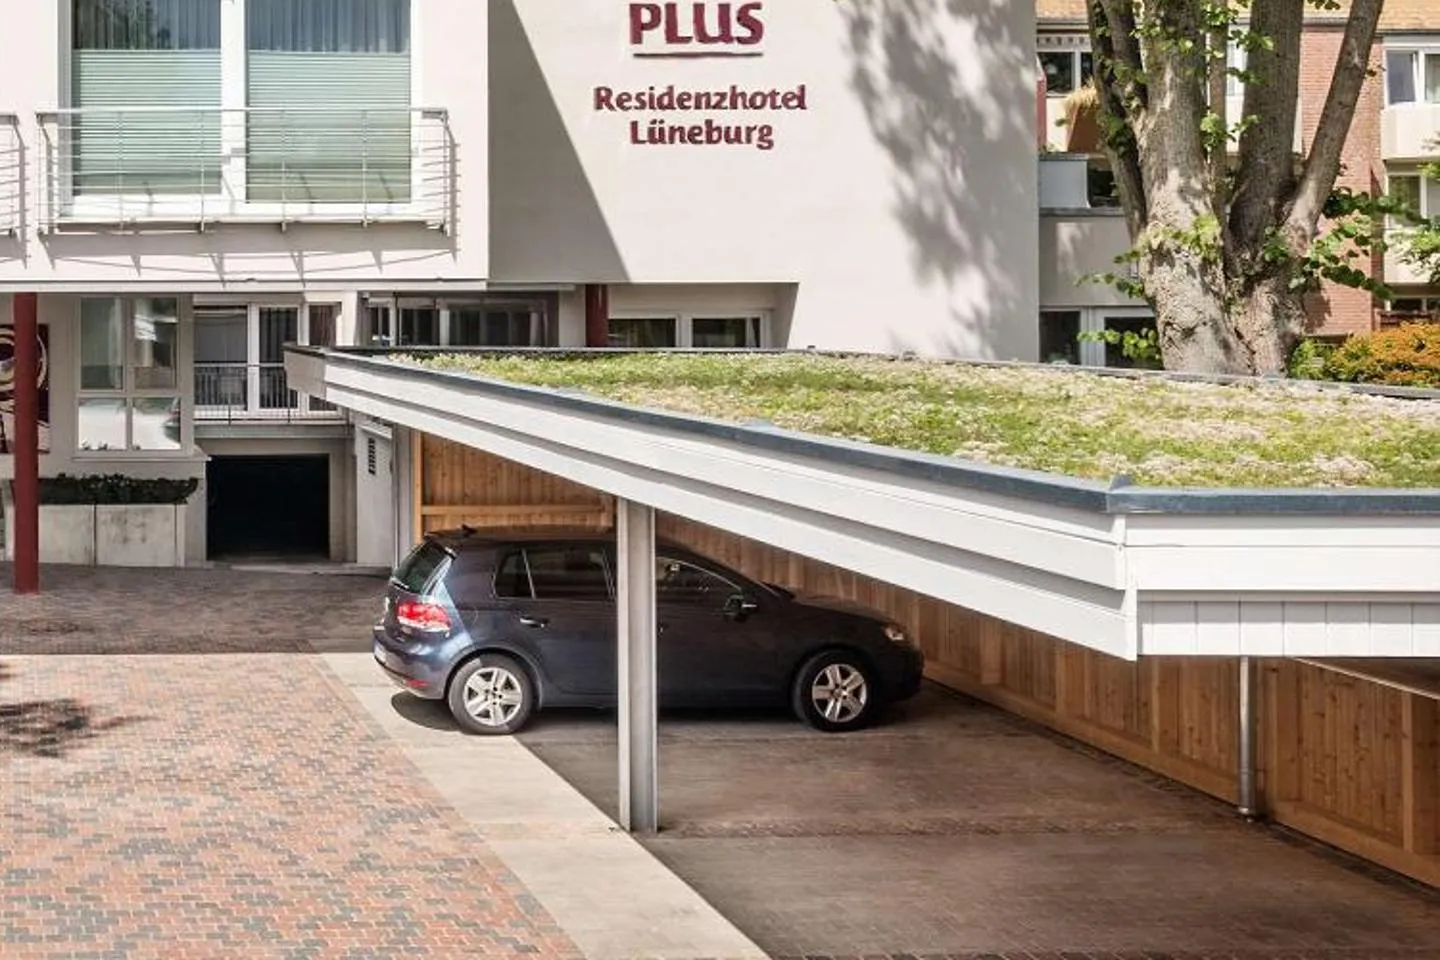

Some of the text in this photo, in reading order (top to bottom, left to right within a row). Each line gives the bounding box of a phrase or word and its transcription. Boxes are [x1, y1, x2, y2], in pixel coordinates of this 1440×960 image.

[629, 2, 764, 45] PLUS
[594, 85, 807, 111] Residenzhotel
[629, 119, 774, 150] Lüneburg
